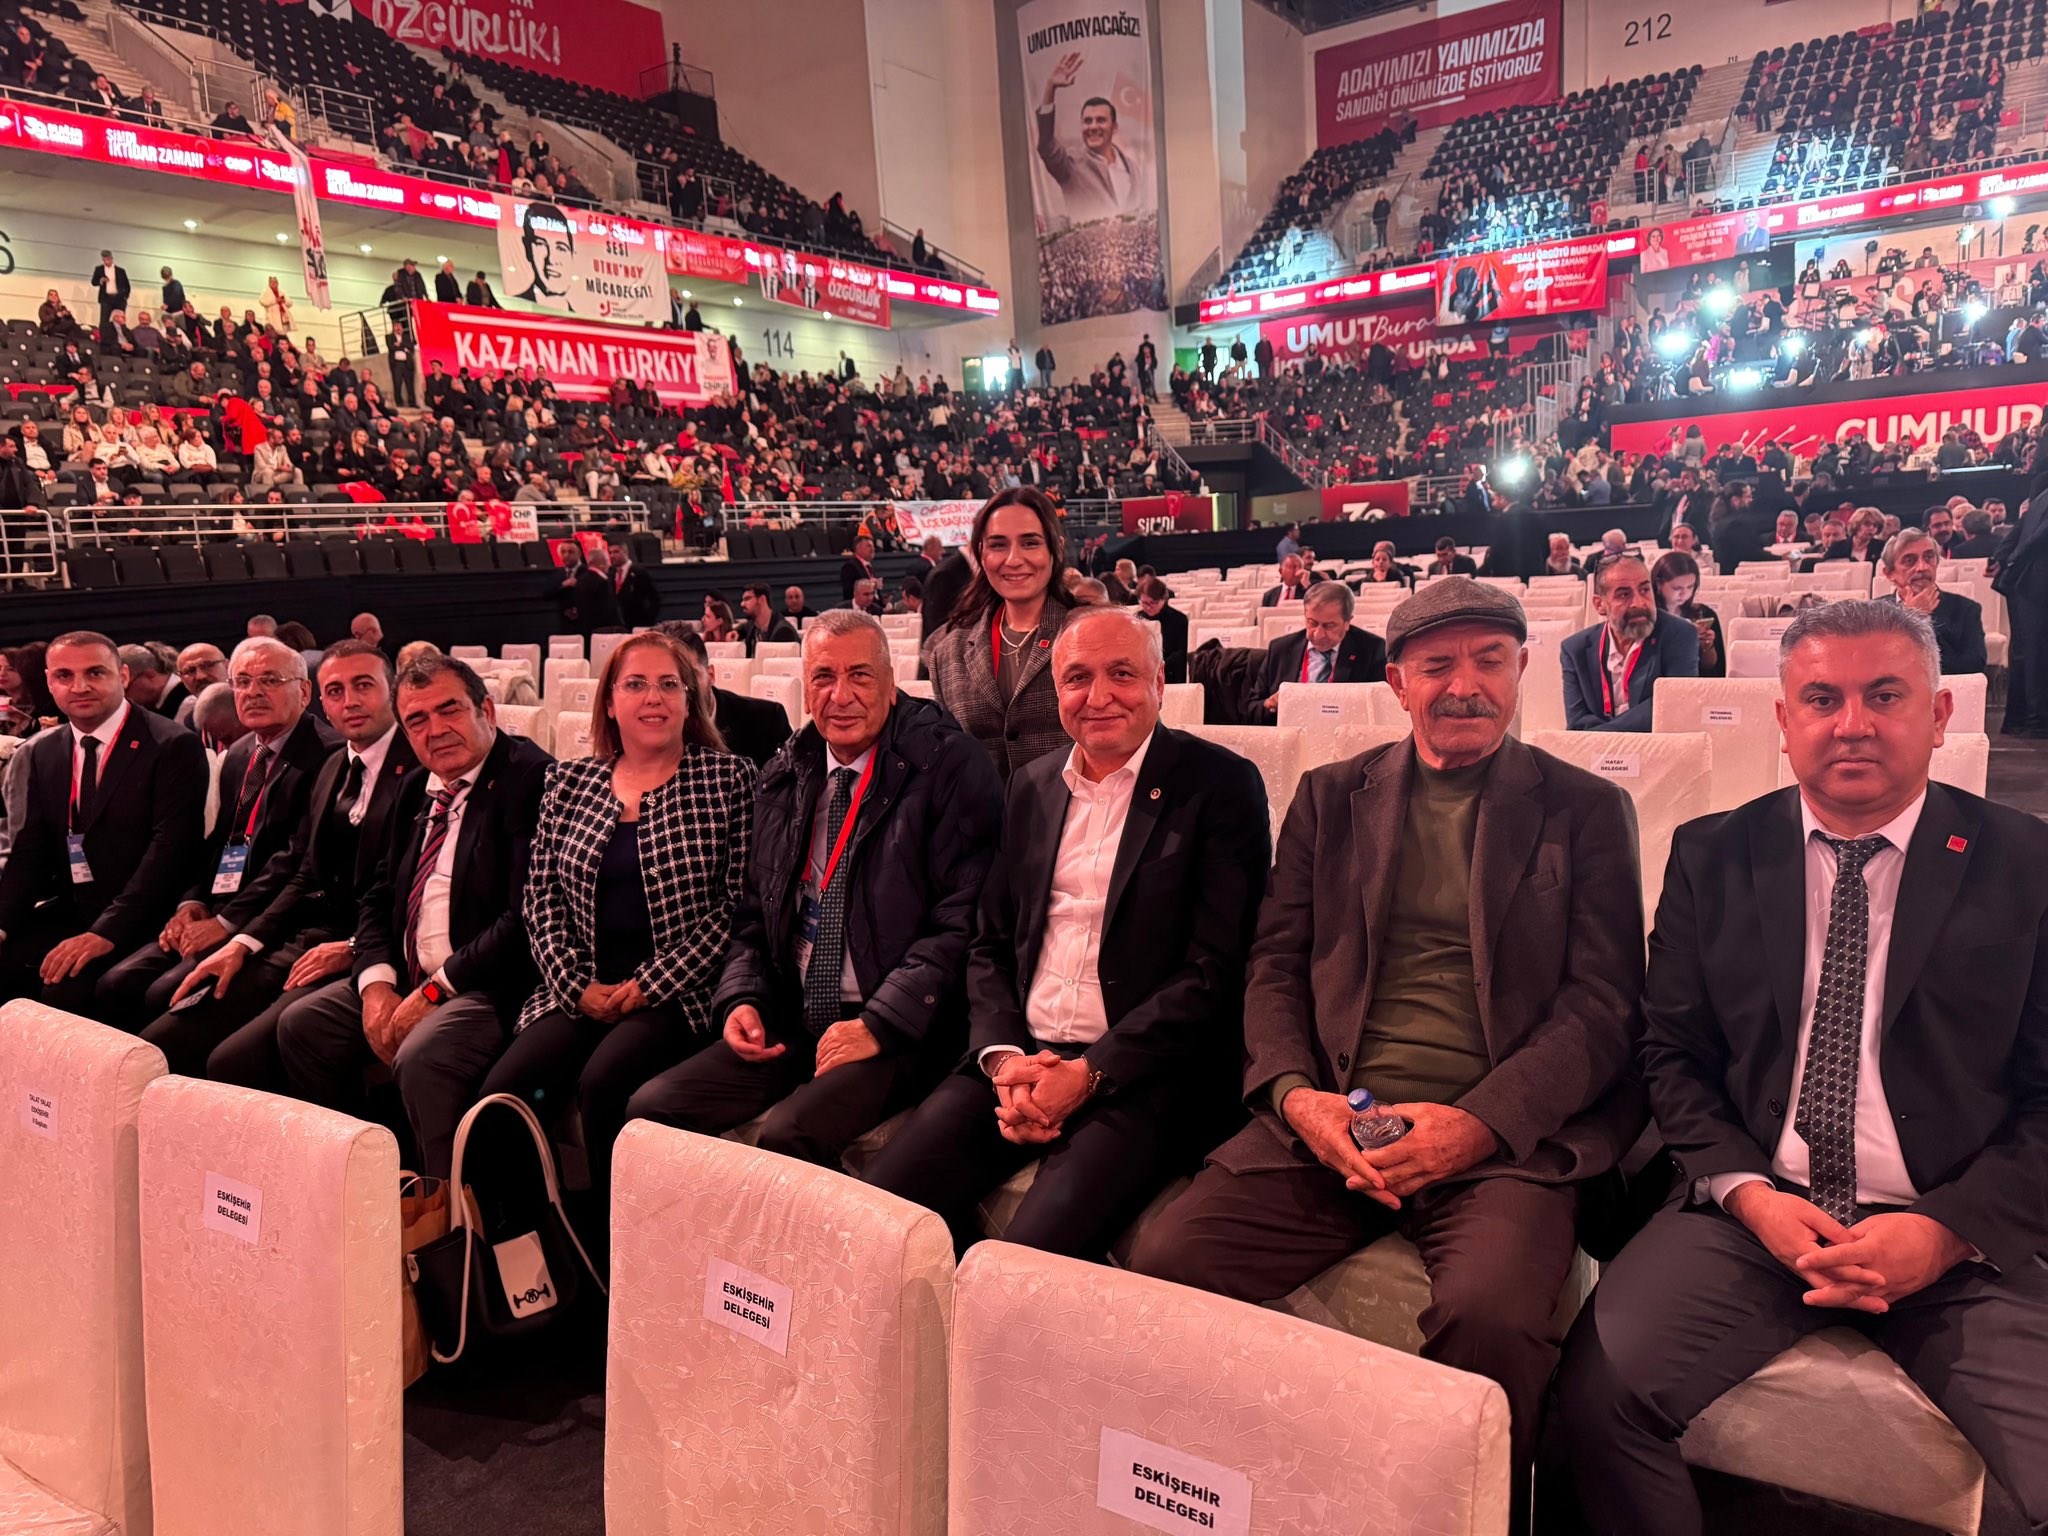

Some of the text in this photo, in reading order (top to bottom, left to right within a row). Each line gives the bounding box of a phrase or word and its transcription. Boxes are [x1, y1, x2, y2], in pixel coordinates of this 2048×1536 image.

[1028, 11, 1141, 54] UNUTMAYACAĞIZ!
[1624, 13, 1673, 47] 212
[1337, 18, 1545, 98] ADAYIMIZI YANIMIZDA
[1335, 51, 1544, 122] SANDIĞI ÖNÜMÜZDE İSTİYORUZ
[762, 327, 795, 360] 114
[1287, 315, 1436, 353] UMUT Bura
[453, 331, 598, 377] KAZANAN
[217, 1189, 252, 1212] ESKİŞEHİR
[217, 1204, 249, 1226] DELEGESİ
[723, 1281, 775, 1313] ESKİŞEHİR
[723, 1300, 771, 1330] DELEGESİ
[1132, 1462, 1221, 1508] ESKİŞEHİR
[1134, 1486, 1215, 1529] DELEGESİ
